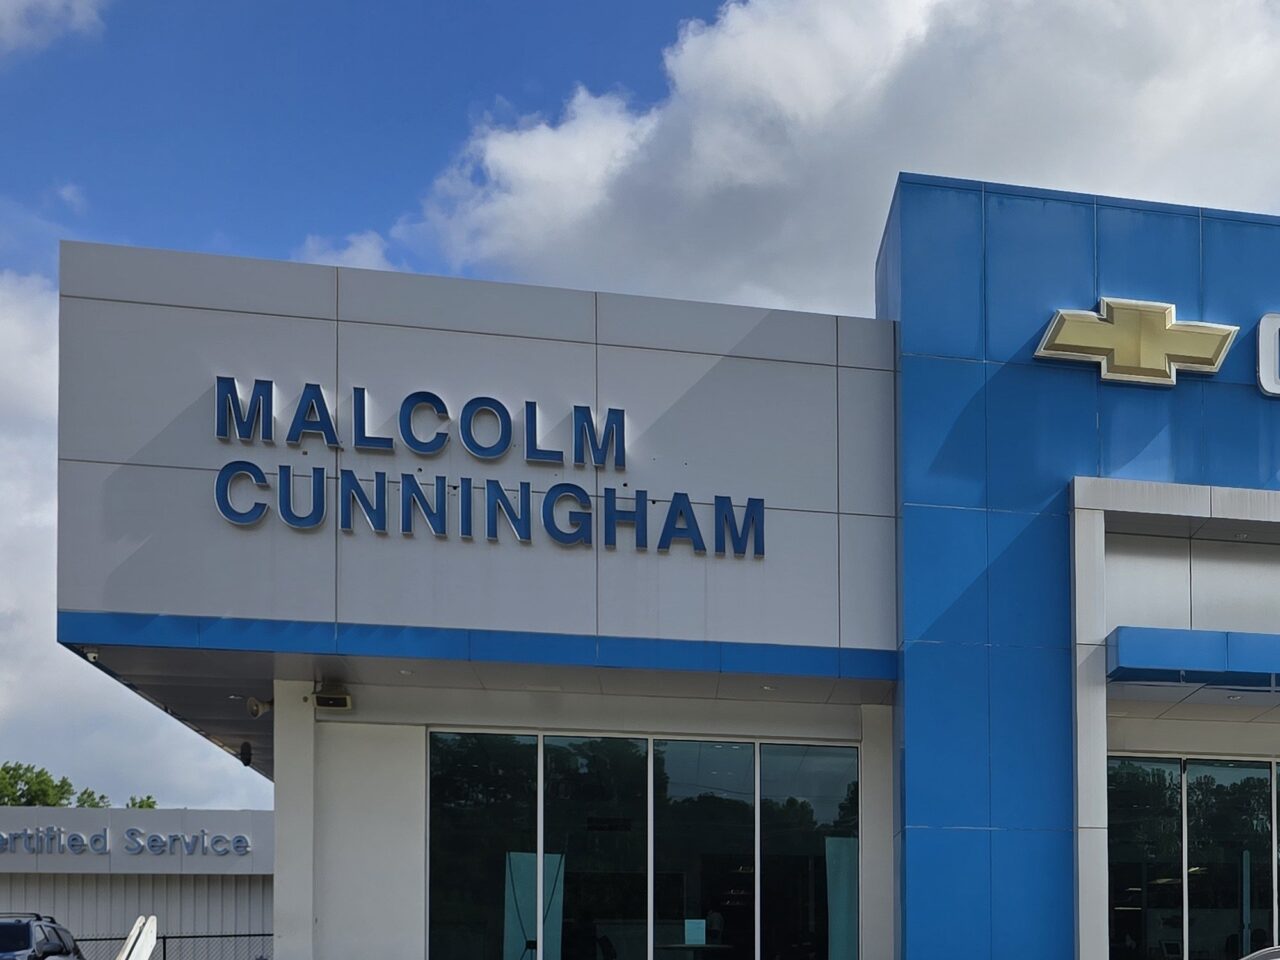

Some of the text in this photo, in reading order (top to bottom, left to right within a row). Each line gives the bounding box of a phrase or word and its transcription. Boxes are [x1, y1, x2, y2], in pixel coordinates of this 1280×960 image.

[215, 375, 626, 470] MALCOLM
[214, 460, 766, 558] CUNNINGHAM
[124, 828, 250, 856] Service
